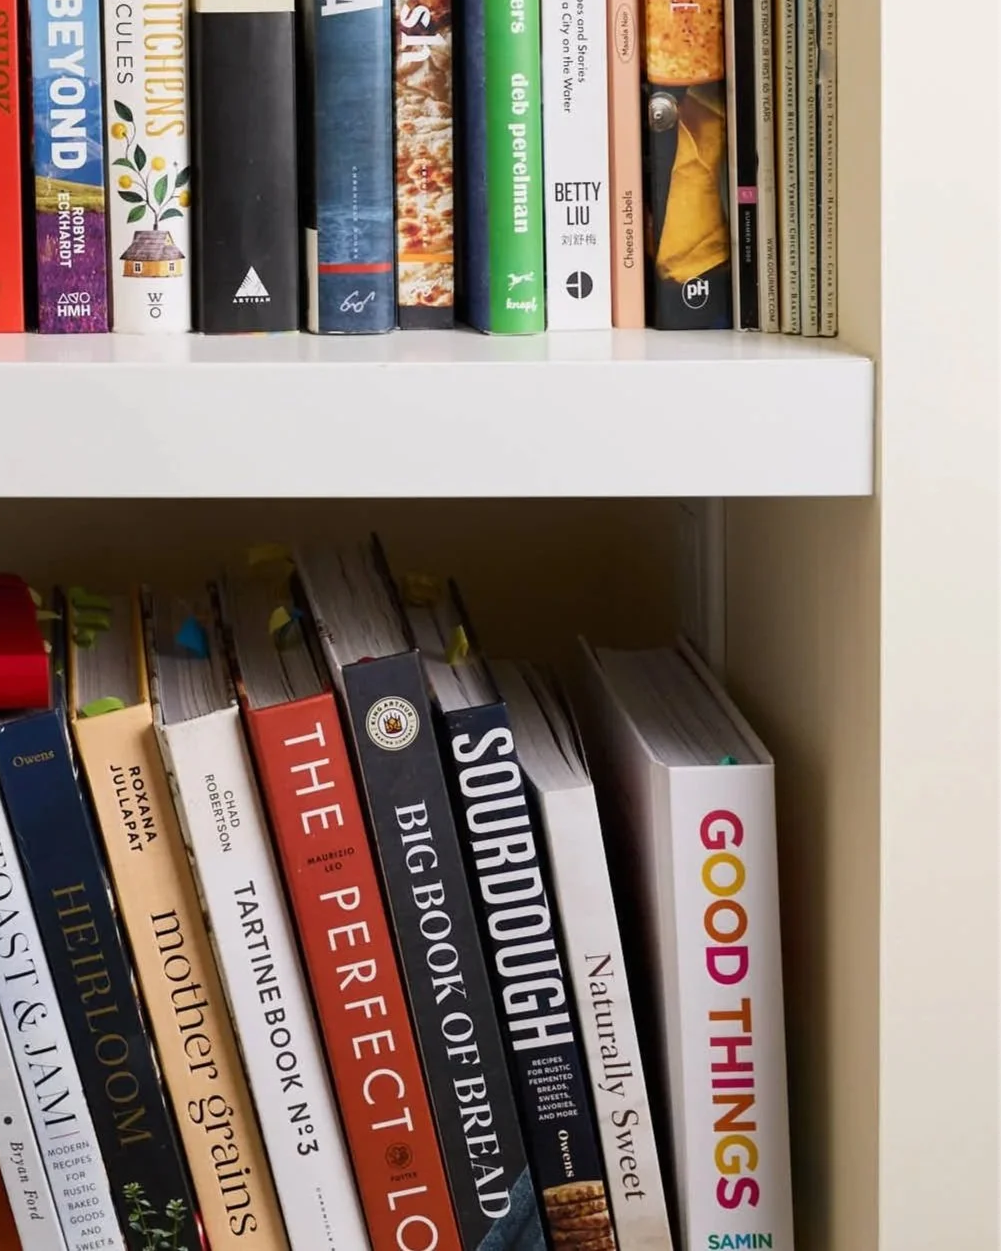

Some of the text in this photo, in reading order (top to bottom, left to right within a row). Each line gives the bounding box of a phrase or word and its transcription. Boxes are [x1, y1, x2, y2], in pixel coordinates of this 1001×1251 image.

[559, 13, 572, 37] City
[561, 39, 568, 53] on
[575, 19, 586, 42] and
[562, 56, 572, 75] the
[562, 78, 573, 113] Water
[576, 45, 586, 83] Stories
[504, 73, 531, 233] deb perelman
[555, 183, 601, 202] BETTY
[567, 207, 589, 225] LIU
[58, 193, 72, 268] ECKHARDT
[73, 206, 84, 254] ROBYN
[622, 190, 634, 269] Cheese Labels
[12, 749, 56, 769] Owens
[110, 764, 143, 853] JULLAPAT
[128, 765, 158, 844] ROXANA
[204, 773, 233, 853] ROBERTSON
[223, 789, 241, 829] CHAD
[395, 799, 438, 877] BIG
[452, 727, 575, 1051] SOURDOUGH
[284, 722, 344, 834] THE
[319, 885, 414, 1131] PERFECT
[412, 880, 467, 1005] BOOK
[12, 1000, 49, 1032] &
[52, 881, 152, 1147] HEIRLOOM
[233, 880, 304, 1093] TARTINE BOOK
[700, 809, 760, 1210] GOOD THINGS
[440, 1012, 482, 1066] OF
[24, 1043, 78, 1129] JAM
[151, 909, 258, 1237] mother grains
[585, 952, 646, 1201] Naturally Sweet
[47, 1141, 90, 1157] MODERN
[52, 1156, 92, 1172] RECIPES
[452, 1074, 512, 1221] BREAD
[558, 1129, 575, 1178] Owens
[708, 1233, 773, 1250] SAMIN
